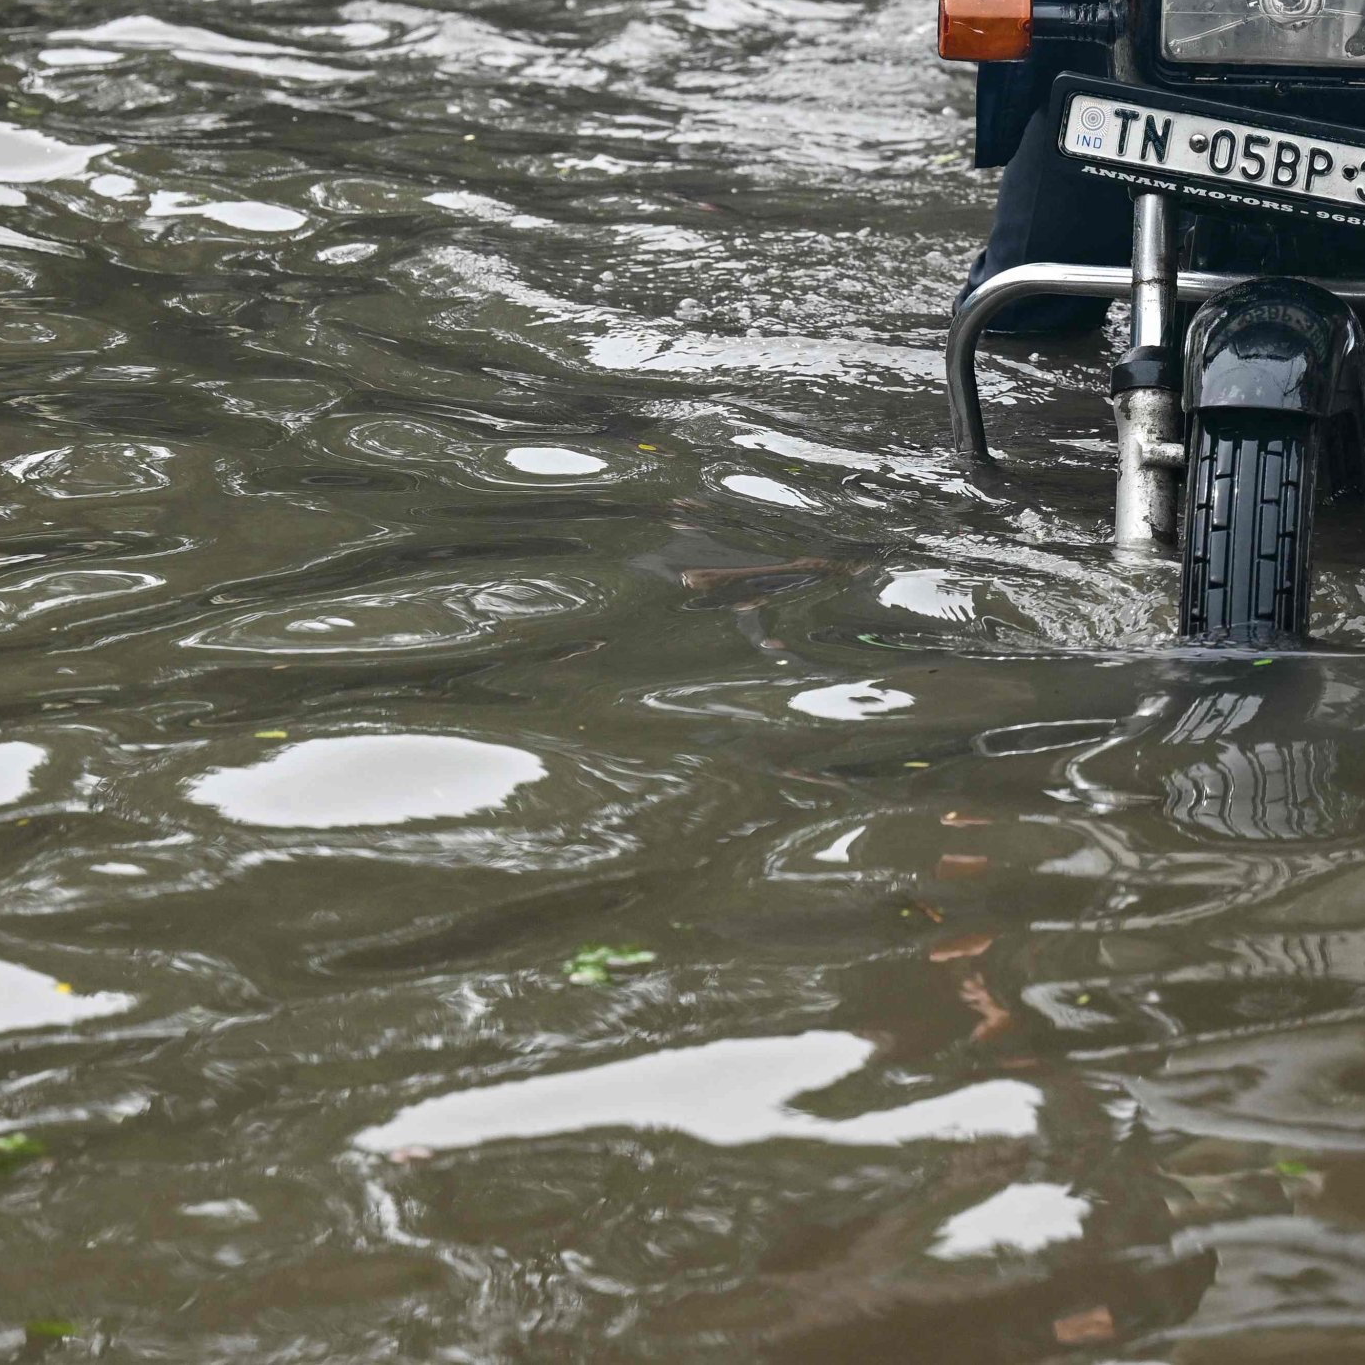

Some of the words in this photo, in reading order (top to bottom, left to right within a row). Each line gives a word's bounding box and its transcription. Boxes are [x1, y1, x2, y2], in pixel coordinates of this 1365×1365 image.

[1076, 135, 1102, 149] IND
[1114, 108, 1173, 163] TN
[1209, 129, 1333, 191] 05BP
[1081, 166, 1178, 191] ANNAM
[1182, 186, 1294, 212] MOTORS
